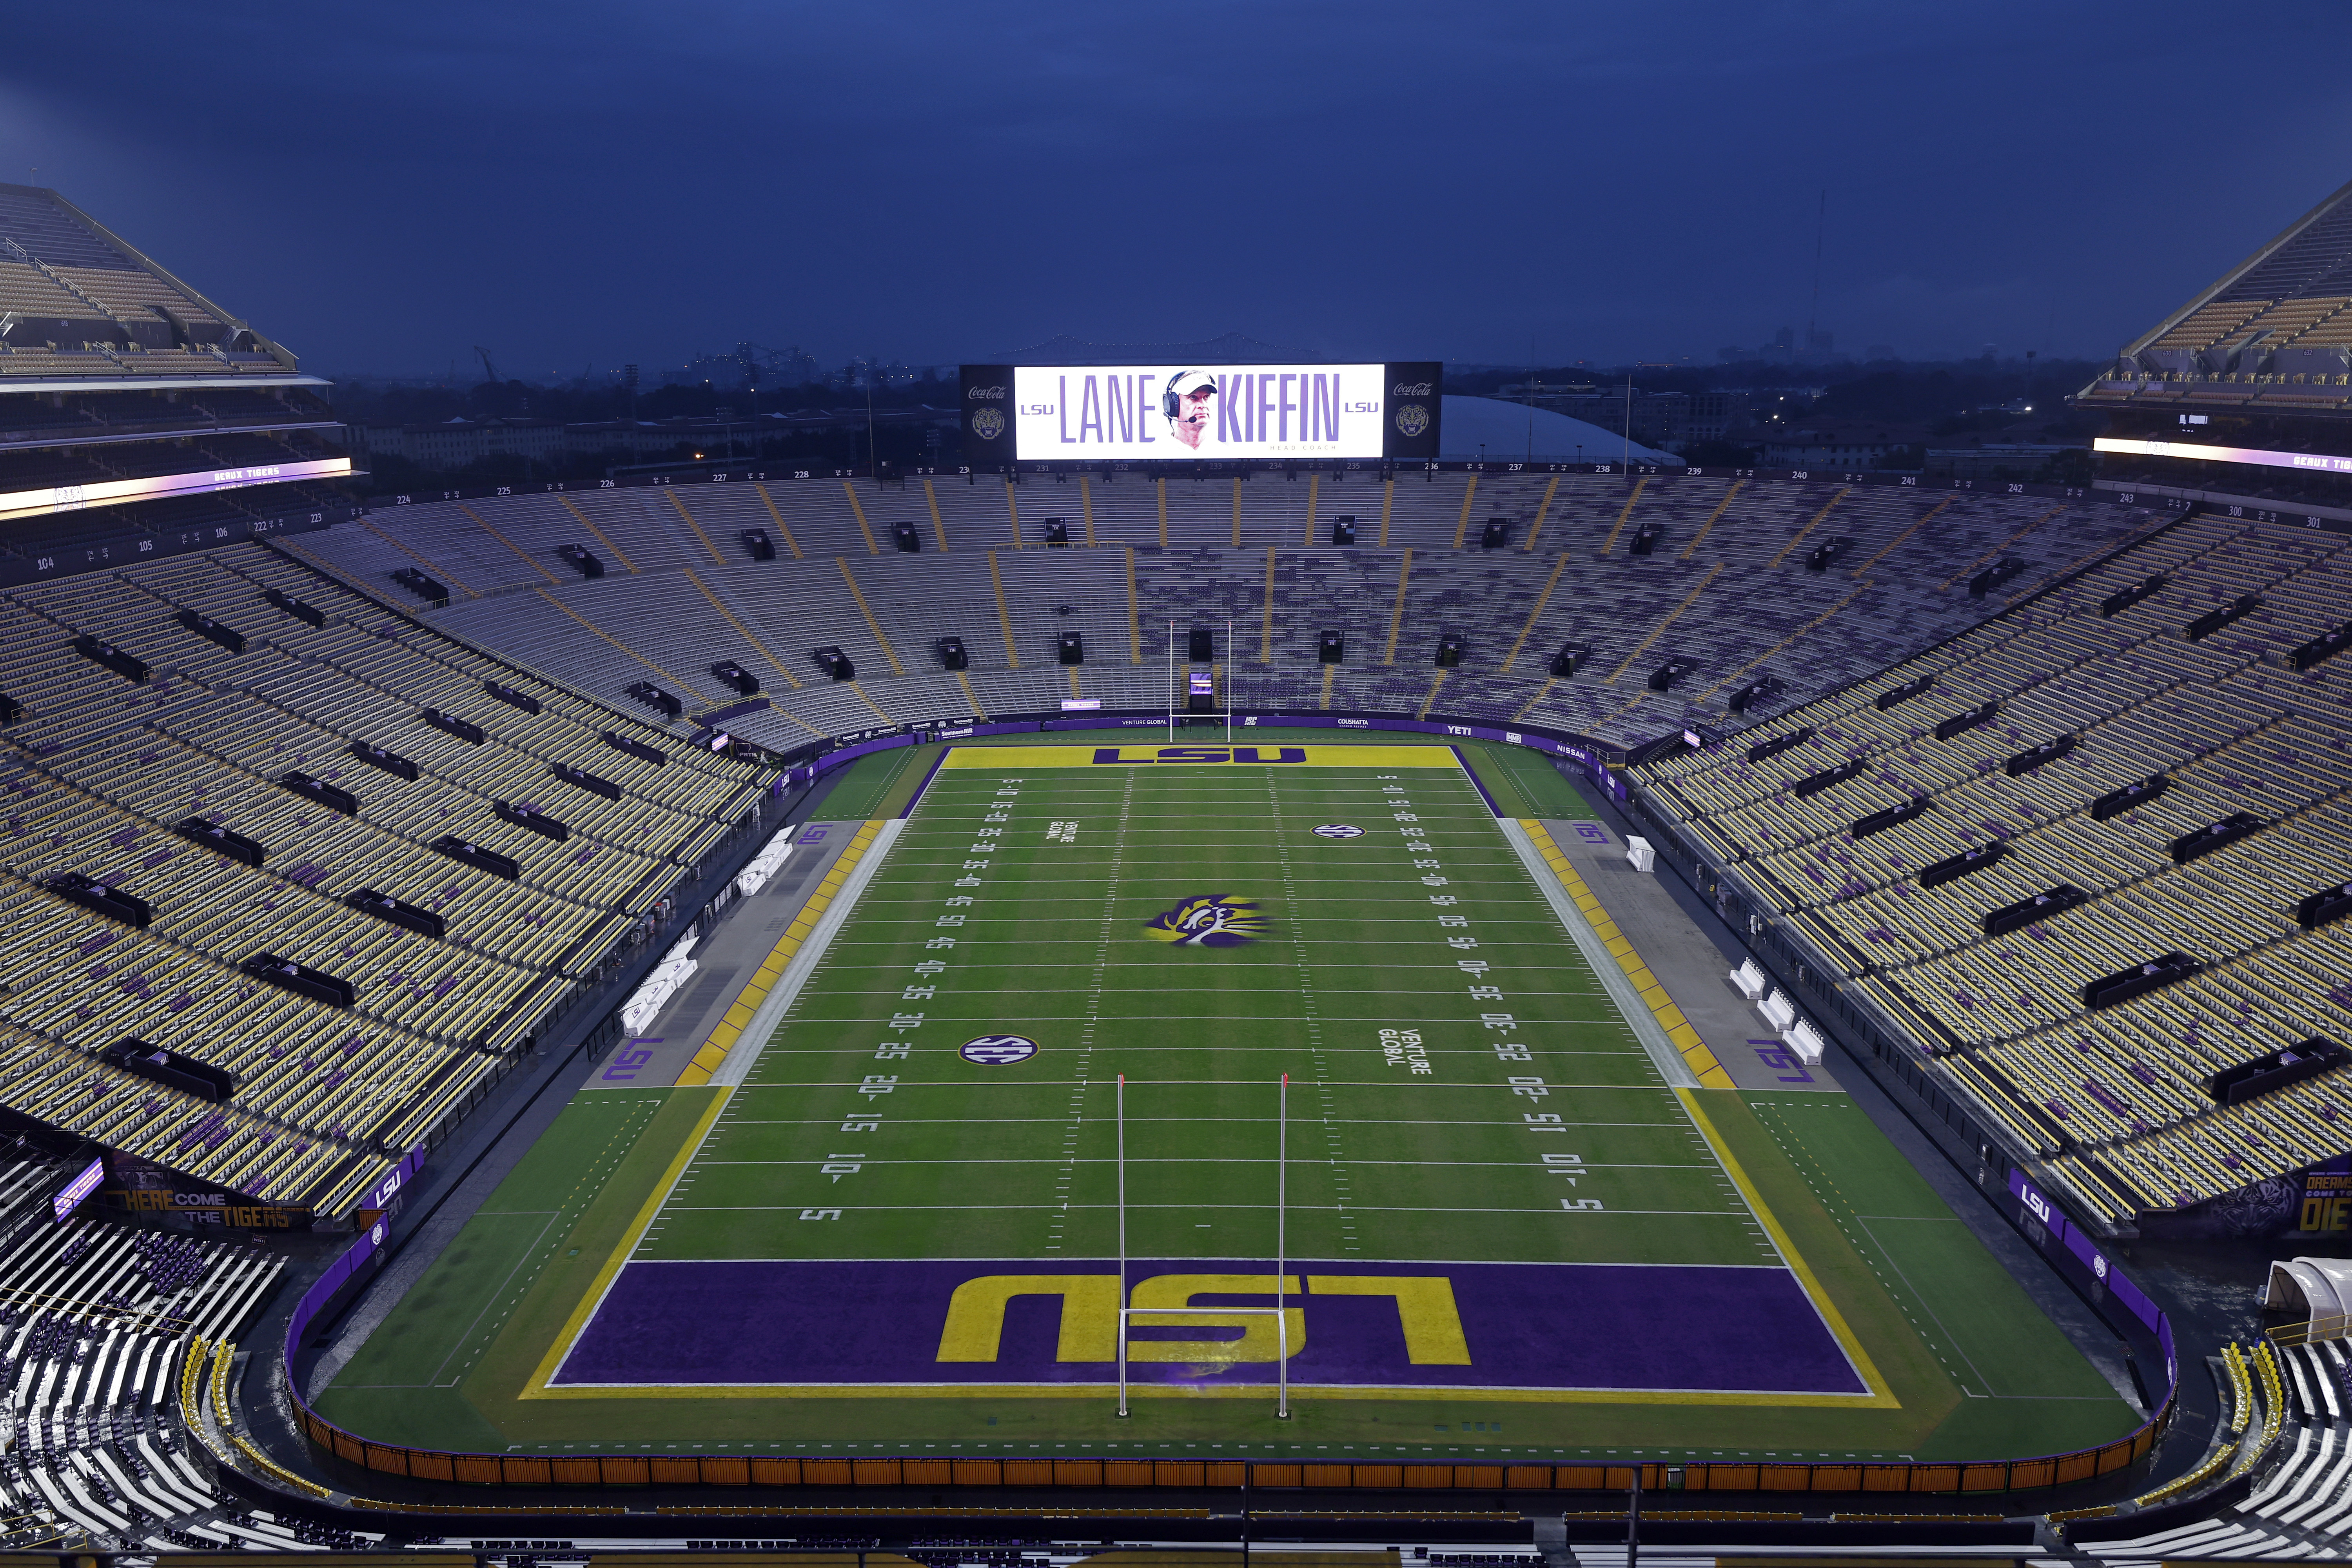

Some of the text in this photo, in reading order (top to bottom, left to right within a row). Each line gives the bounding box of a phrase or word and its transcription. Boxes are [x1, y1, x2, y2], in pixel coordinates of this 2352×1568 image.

[968, 386, 1006, 399] Coca-Cola
[1394, 383, 1432, 396] Coca-Cola
[1021, 405, 1054, 415] LSU
[1060, 374, 1339, 443] LANE KIFFIN
[1345, 403, 1378, 412] LSU
[2294, 456, 2352, 470] GEAUX TIG
[214, 467, 279, 481] GEAUX TIGERS
[1901, 476, 1915, 485] 241
[2008, 484, 2023, 493] 242
[397, 495, 410, 504] 224
[2120, 493, 2133, 503] 243
[310, 513, 321, 523] 223
[2229, 506, 2242, 517] 300
[254, 521, 267, 532] 222
[2307, 517, 2320, 528] 301
[216, 528, 227, 537] 106
[139, 540, 152, 552] 105
[37, 557, 54, 570] 104
[1447, 725, 1471, 735] YETI
[1093, 748, 1307, 764] LSU
[1557, 744, 1585, 759] NISSAN
[1393, 813, 1418, 822] 20
[797, 824, 833, 845] LSU
[978, 828, 1002, 837] 25
[1046, 821, 1064, 839] GLOBAL
[1060, 821, 1079, 842] VENTURE
[1399, 828, 1425, 836] 25
[1572, 824, 1610, 844] LSU
[970, 843, 996, 852] 30
[1406, 843, 1433, 852] 30
[962, 860, 989, 869] 35
[1413, 859, 1441, 869] 35
[954, 877, 981, 887] 40
[1421, 877, 1448, 886] 40
[945, 896, 973, 906] 45
[1429, 895, 1457, 906] 45
[935, 915, 966, 927] 50
[1437, 915, 1468, 927] 50
[926, 937, 956, 949] 45
[1447, 937, 1479, 949] 45
[914, 960, 946, 973] 40
[1457, 960, 1490, 973] 40
[902, 985, 936, 999] 35
[1468, 986, 1504, 1000] 35
[632, 1006, 640, 1018] LSU
[888, 1013, 924, 1028] 30
[1480, 1013, 1517, 1029] 30
[874, 1043, 912, 1059] 25
[1378, 1029, 1406, 1066] GLOBAL
[1401, 1029, 1432, 1074] VENTURE
[1493, 1044, 1533, 1060] 25
[602, 1038, 665, 1080] LSU
[1746, 1040, 1815, 1082] LSU
[858, 1075, 898, 1093] 20
[1508, 1076, 1550, 1095] 20
[840, 1114, 882, 1132] 15
[1523, 1113, 1567, 1132] 15
[820, 1154, 866, 1173] 10
[1541, 1154, 1587, 1174] 10
[64, 1173, 95, 1205] GEAUX TIGERS
[376, 1170, 401, 1208] LSU
[2307, 1176, 2352, 1189] DREAMS
[124, 1191, 225, 1210] HERE COME
[1560, 1199, 1604, 1210] 5
[2022, 1184, 2049, 1222] LSU
[185, 1207, 289, 1227] THE TIGERS
[799, 1210, 842, 1220] 5
[2300, 1198, 2352, 1230] DIE
[935, 1274, 1472, 1365] LSU
